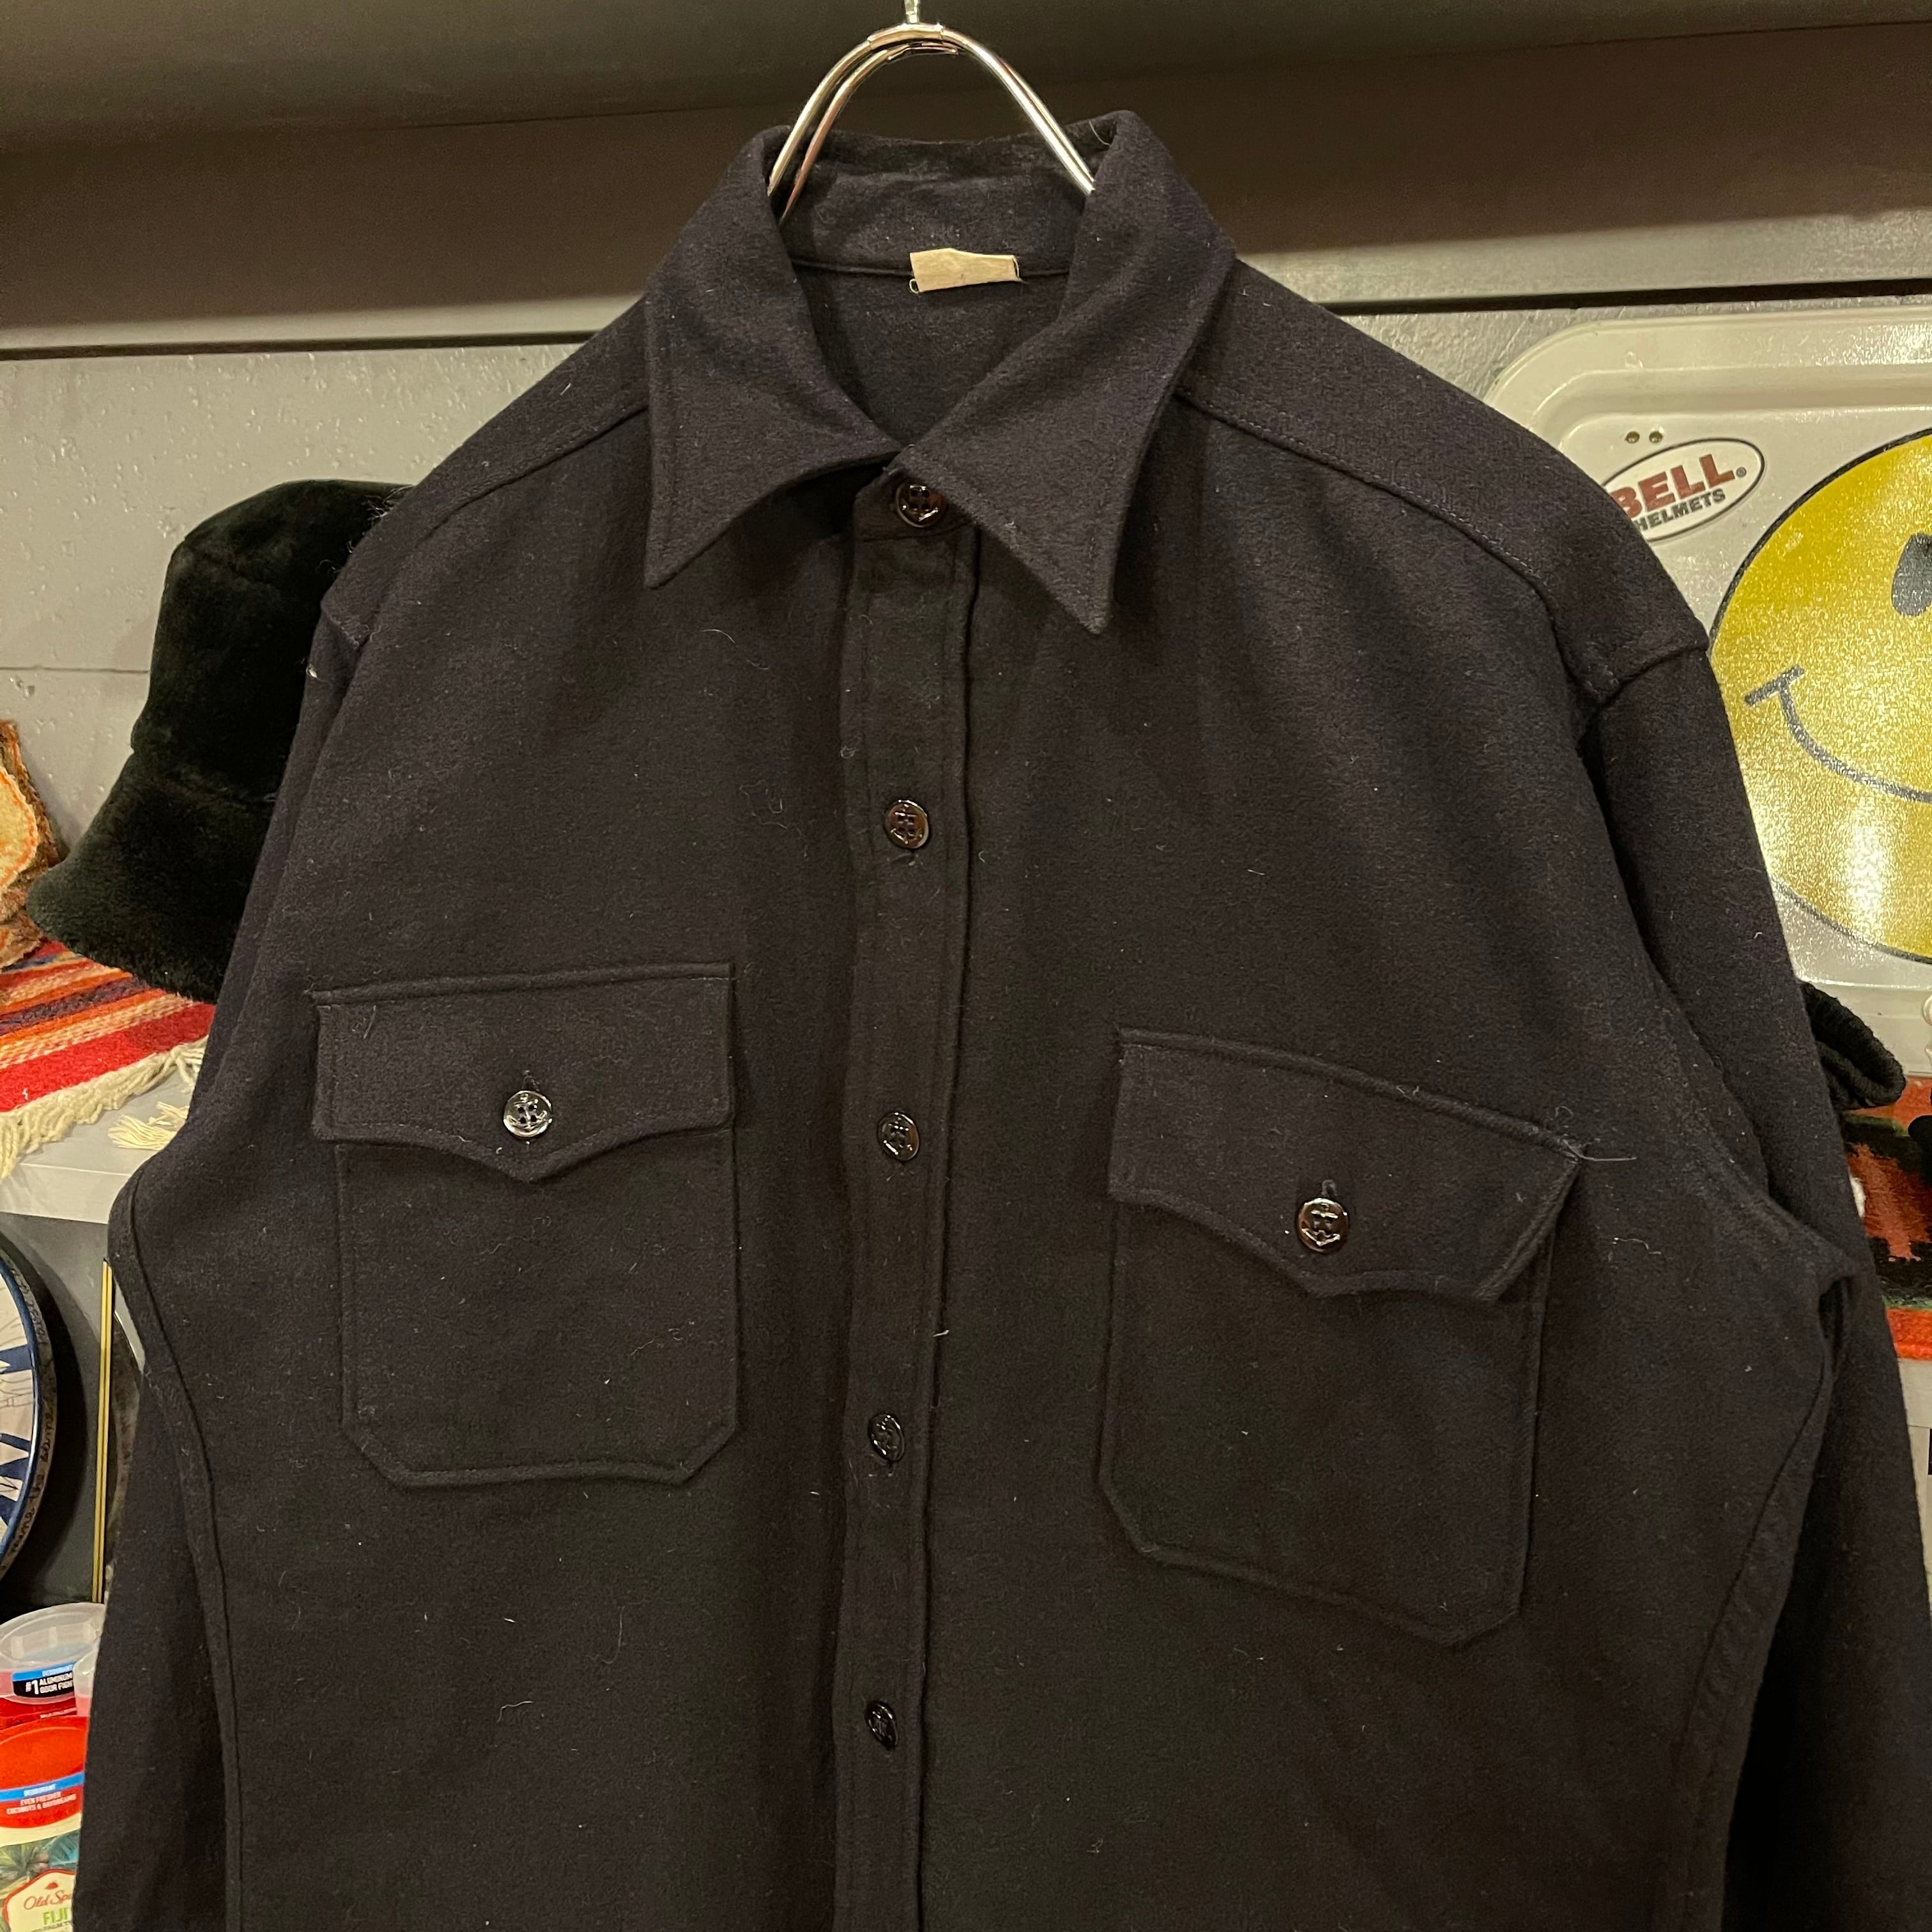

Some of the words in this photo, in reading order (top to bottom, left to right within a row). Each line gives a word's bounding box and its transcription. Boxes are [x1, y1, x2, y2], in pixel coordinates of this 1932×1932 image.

[1611, 454, 1735, 518] BELL
[1634, 488, 1726, 531] HELMETS
[26, 1680, 39, 1695] #1
[24, 1896, 49, 1910] Old
[43, 1907, 68, 1925] FIJI
